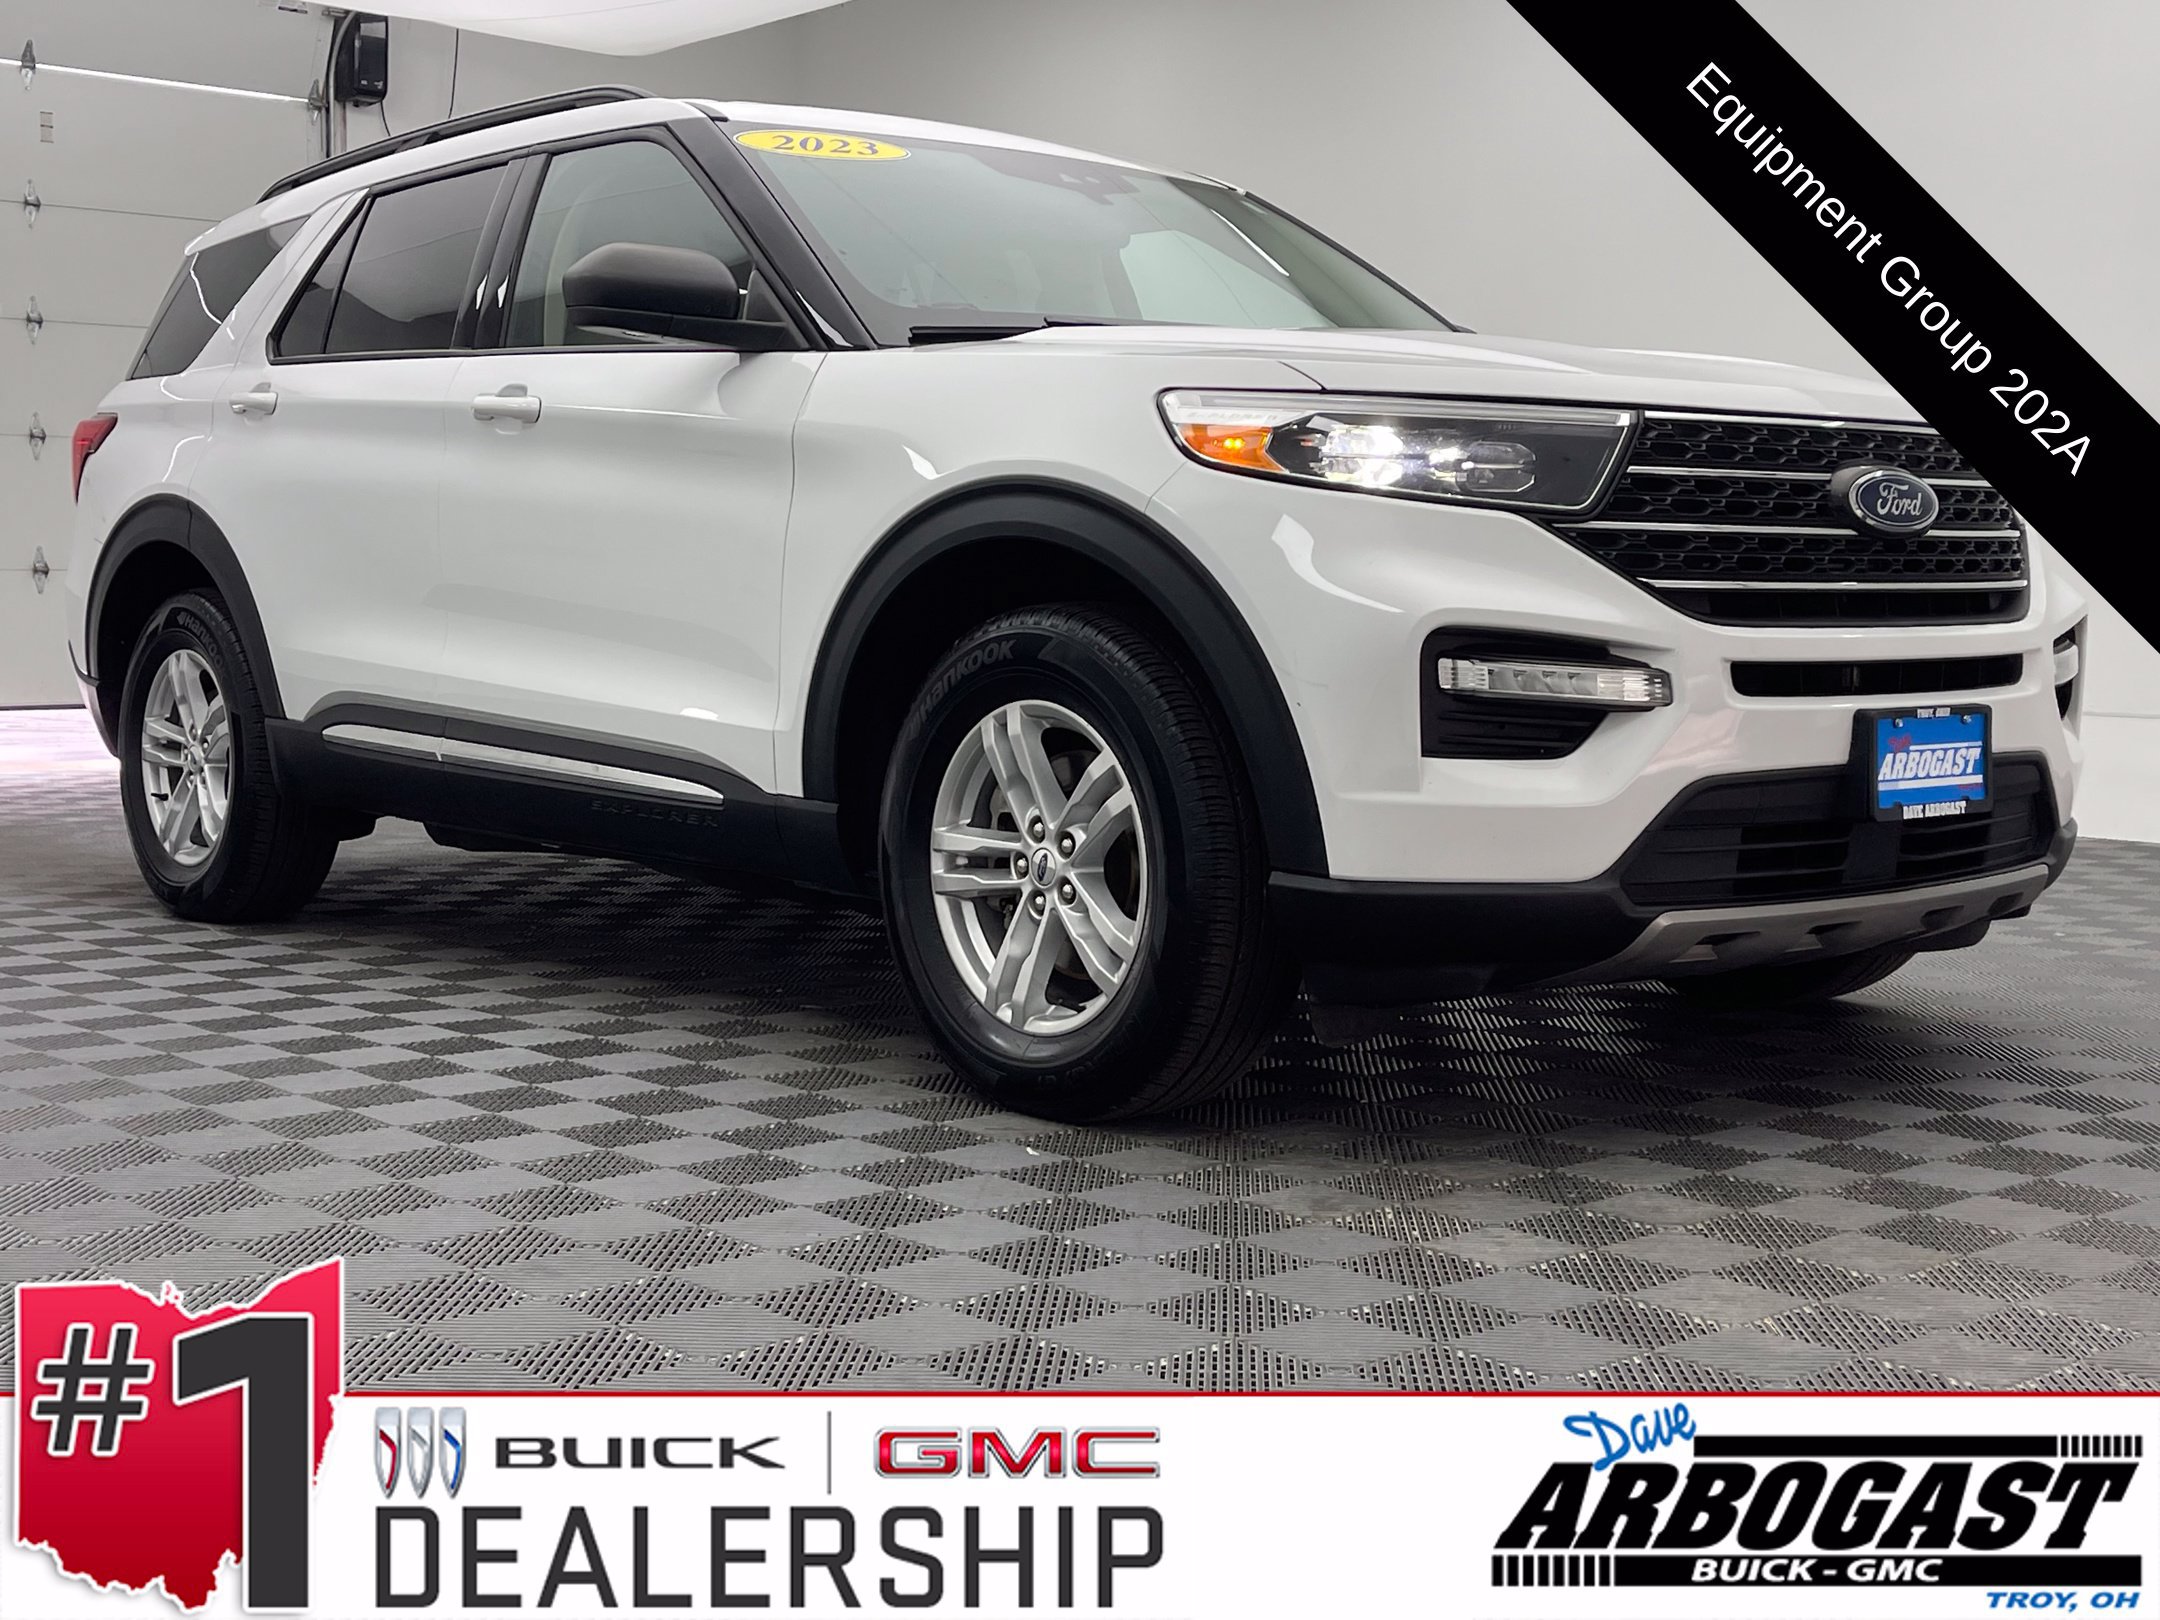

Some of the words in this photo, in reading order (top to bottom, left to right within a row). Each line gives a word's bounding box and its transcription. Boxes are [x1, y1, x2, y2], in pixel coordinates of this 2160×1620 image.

[771, 135, 879, 155] 2023
[1877, 482, 1922, 515] Ford
[1877, 747, 1982, 781] ARBOGAST
